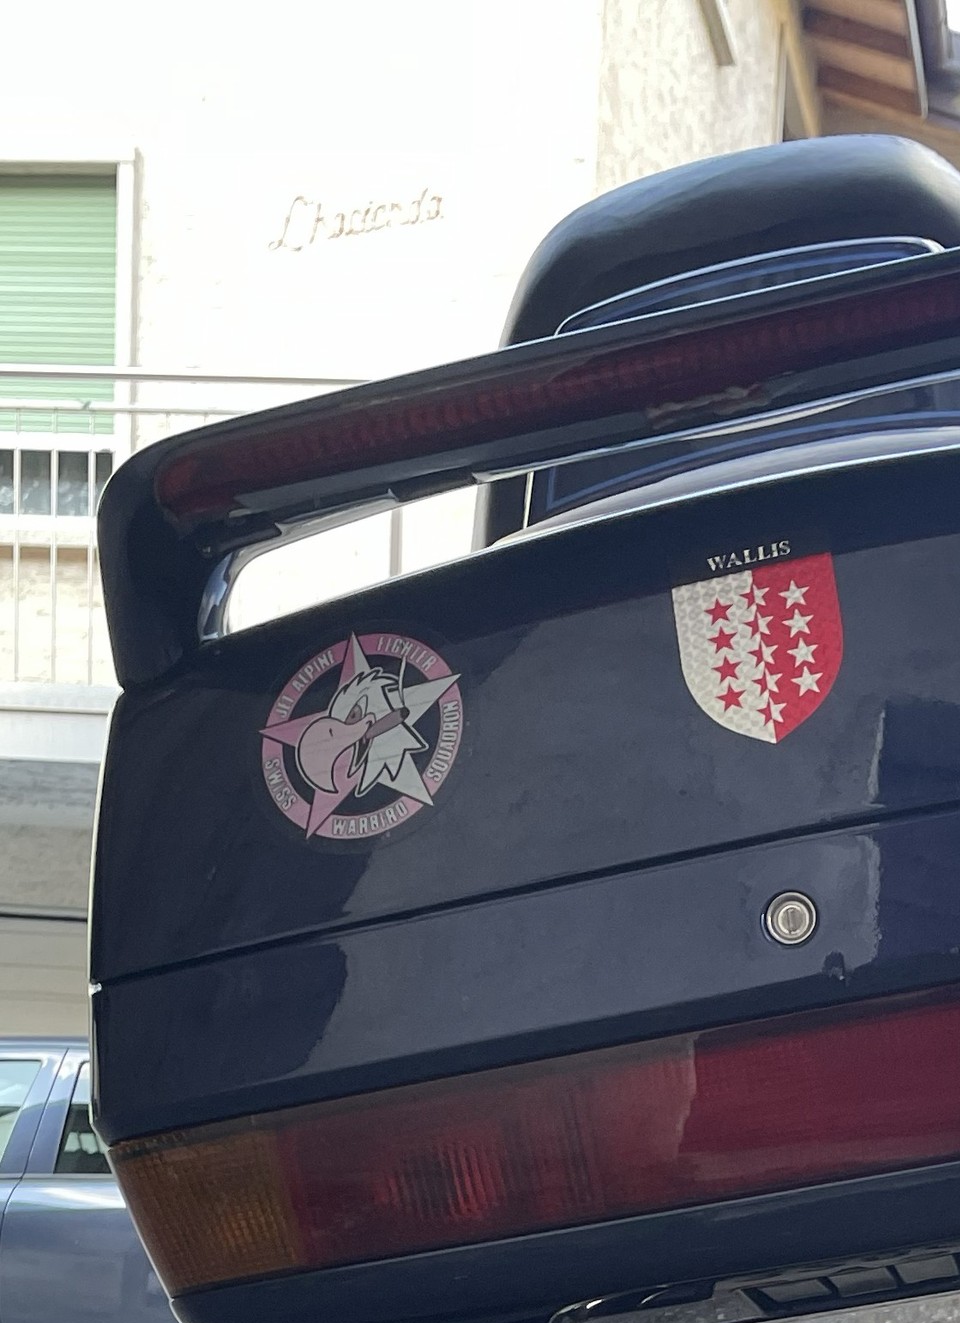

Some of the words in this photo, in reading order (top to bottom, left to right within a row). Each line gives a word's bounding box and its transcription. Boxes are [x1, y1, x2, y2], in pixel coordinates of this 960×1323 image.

[706, 540, 791, 572] WALLIS
[275, 694, 294, 719] JET
[291, 650, 336, 693] ALPINE
[377, 636, 437, 672] FIGHTER
[265, 757, 298, 812] SWISS
[331, 801, 409, 836] WARBIRD
[426, 700, 459, 782] SQUADRON
